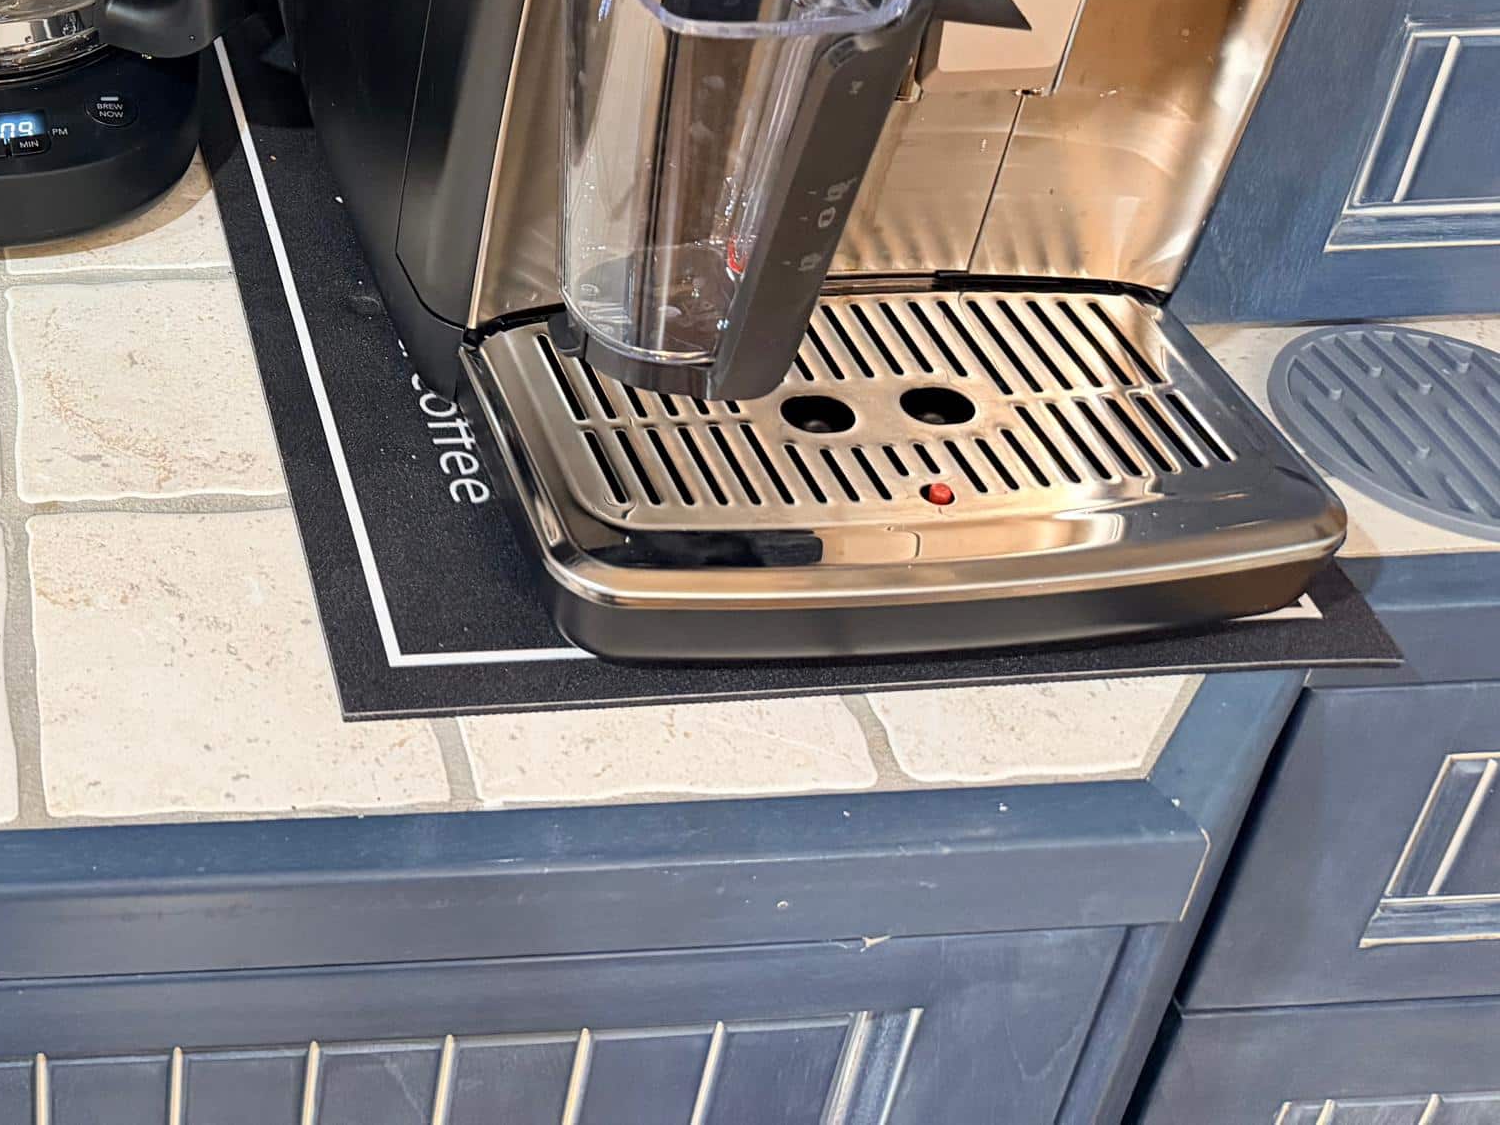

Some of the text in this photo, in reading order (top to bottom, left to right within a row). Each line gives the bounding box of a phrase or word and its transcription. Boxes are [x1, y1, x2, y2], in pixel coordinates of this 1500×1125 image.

[96, 103, 124, 111] BREW
[99, 110, 124, 118] NOW
[52, 127, 68, 136] PM
[19, 139, 39, 149] MIN
